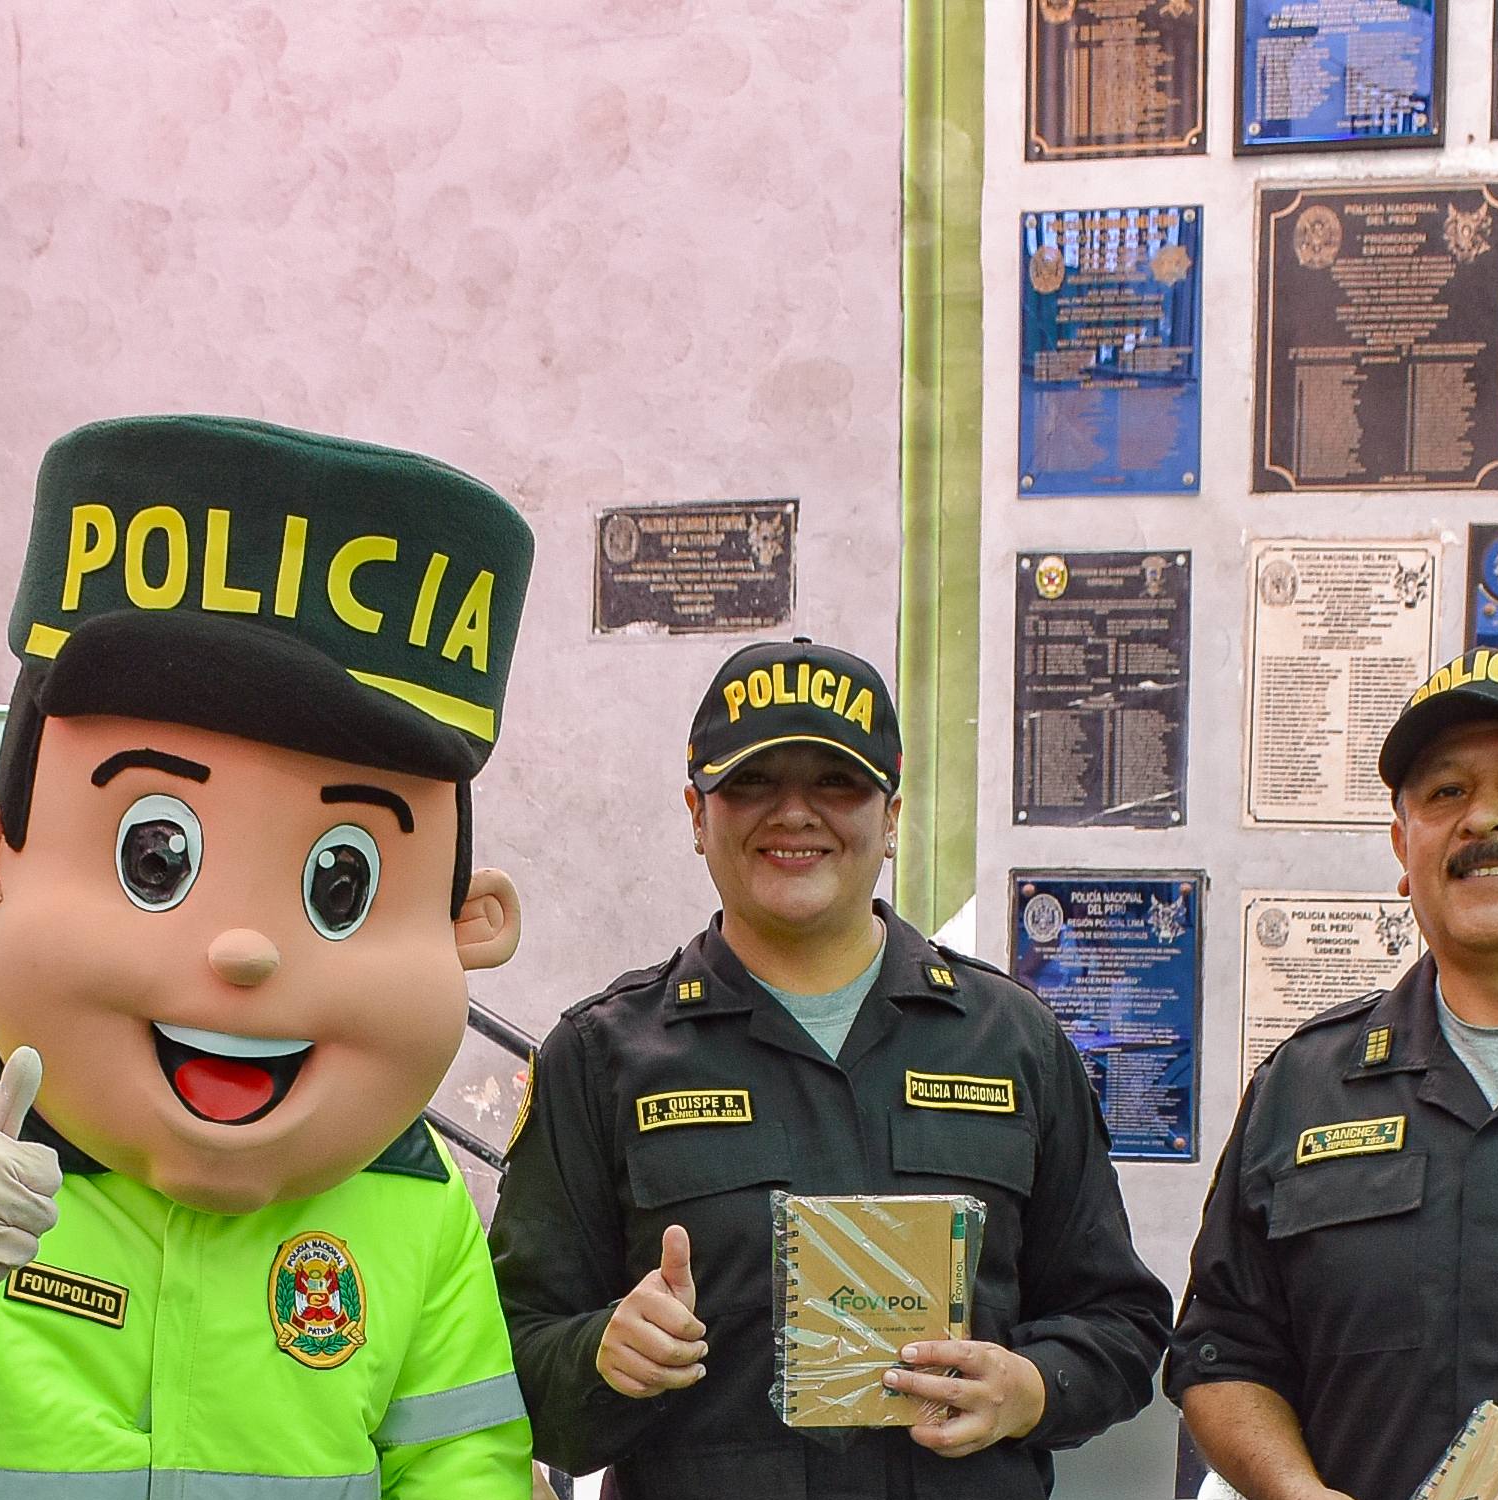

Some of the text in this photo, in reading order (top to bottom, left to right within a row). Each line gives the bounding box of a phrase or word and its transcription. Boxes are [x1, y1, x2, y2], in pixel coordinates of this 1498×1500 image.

[61, 503, 495, 673] POLICIA
[723, 663, 873, 735] POLICIA
[1071, 890, 1143, 904] POLICÍA NACIONAL
[1087, 904, 1103, 915] DEL
[1328, 911, 1373, 920] NACIONAL
[1310, 924, 1327, 932] DEL
[911, 1080, 1008, 1103] POLICIA NACIONAL
[648, 1096, 739, 1114] B. QUISPE B.
[1305, 1134, 1318, 1147] A.
[1324, 1125, 1379, 1143] SANCHEZ
[1325, 1138, 1364, 1151] SUPERIOR
[311, 1239, 344, 1267] NACIONAL
[19, 1271, 117, 1313] FOVIPOLITO
[841, 1296, 928, 1311] FOVIPOL
[307, 1326, 333, 1335] PATRIA
